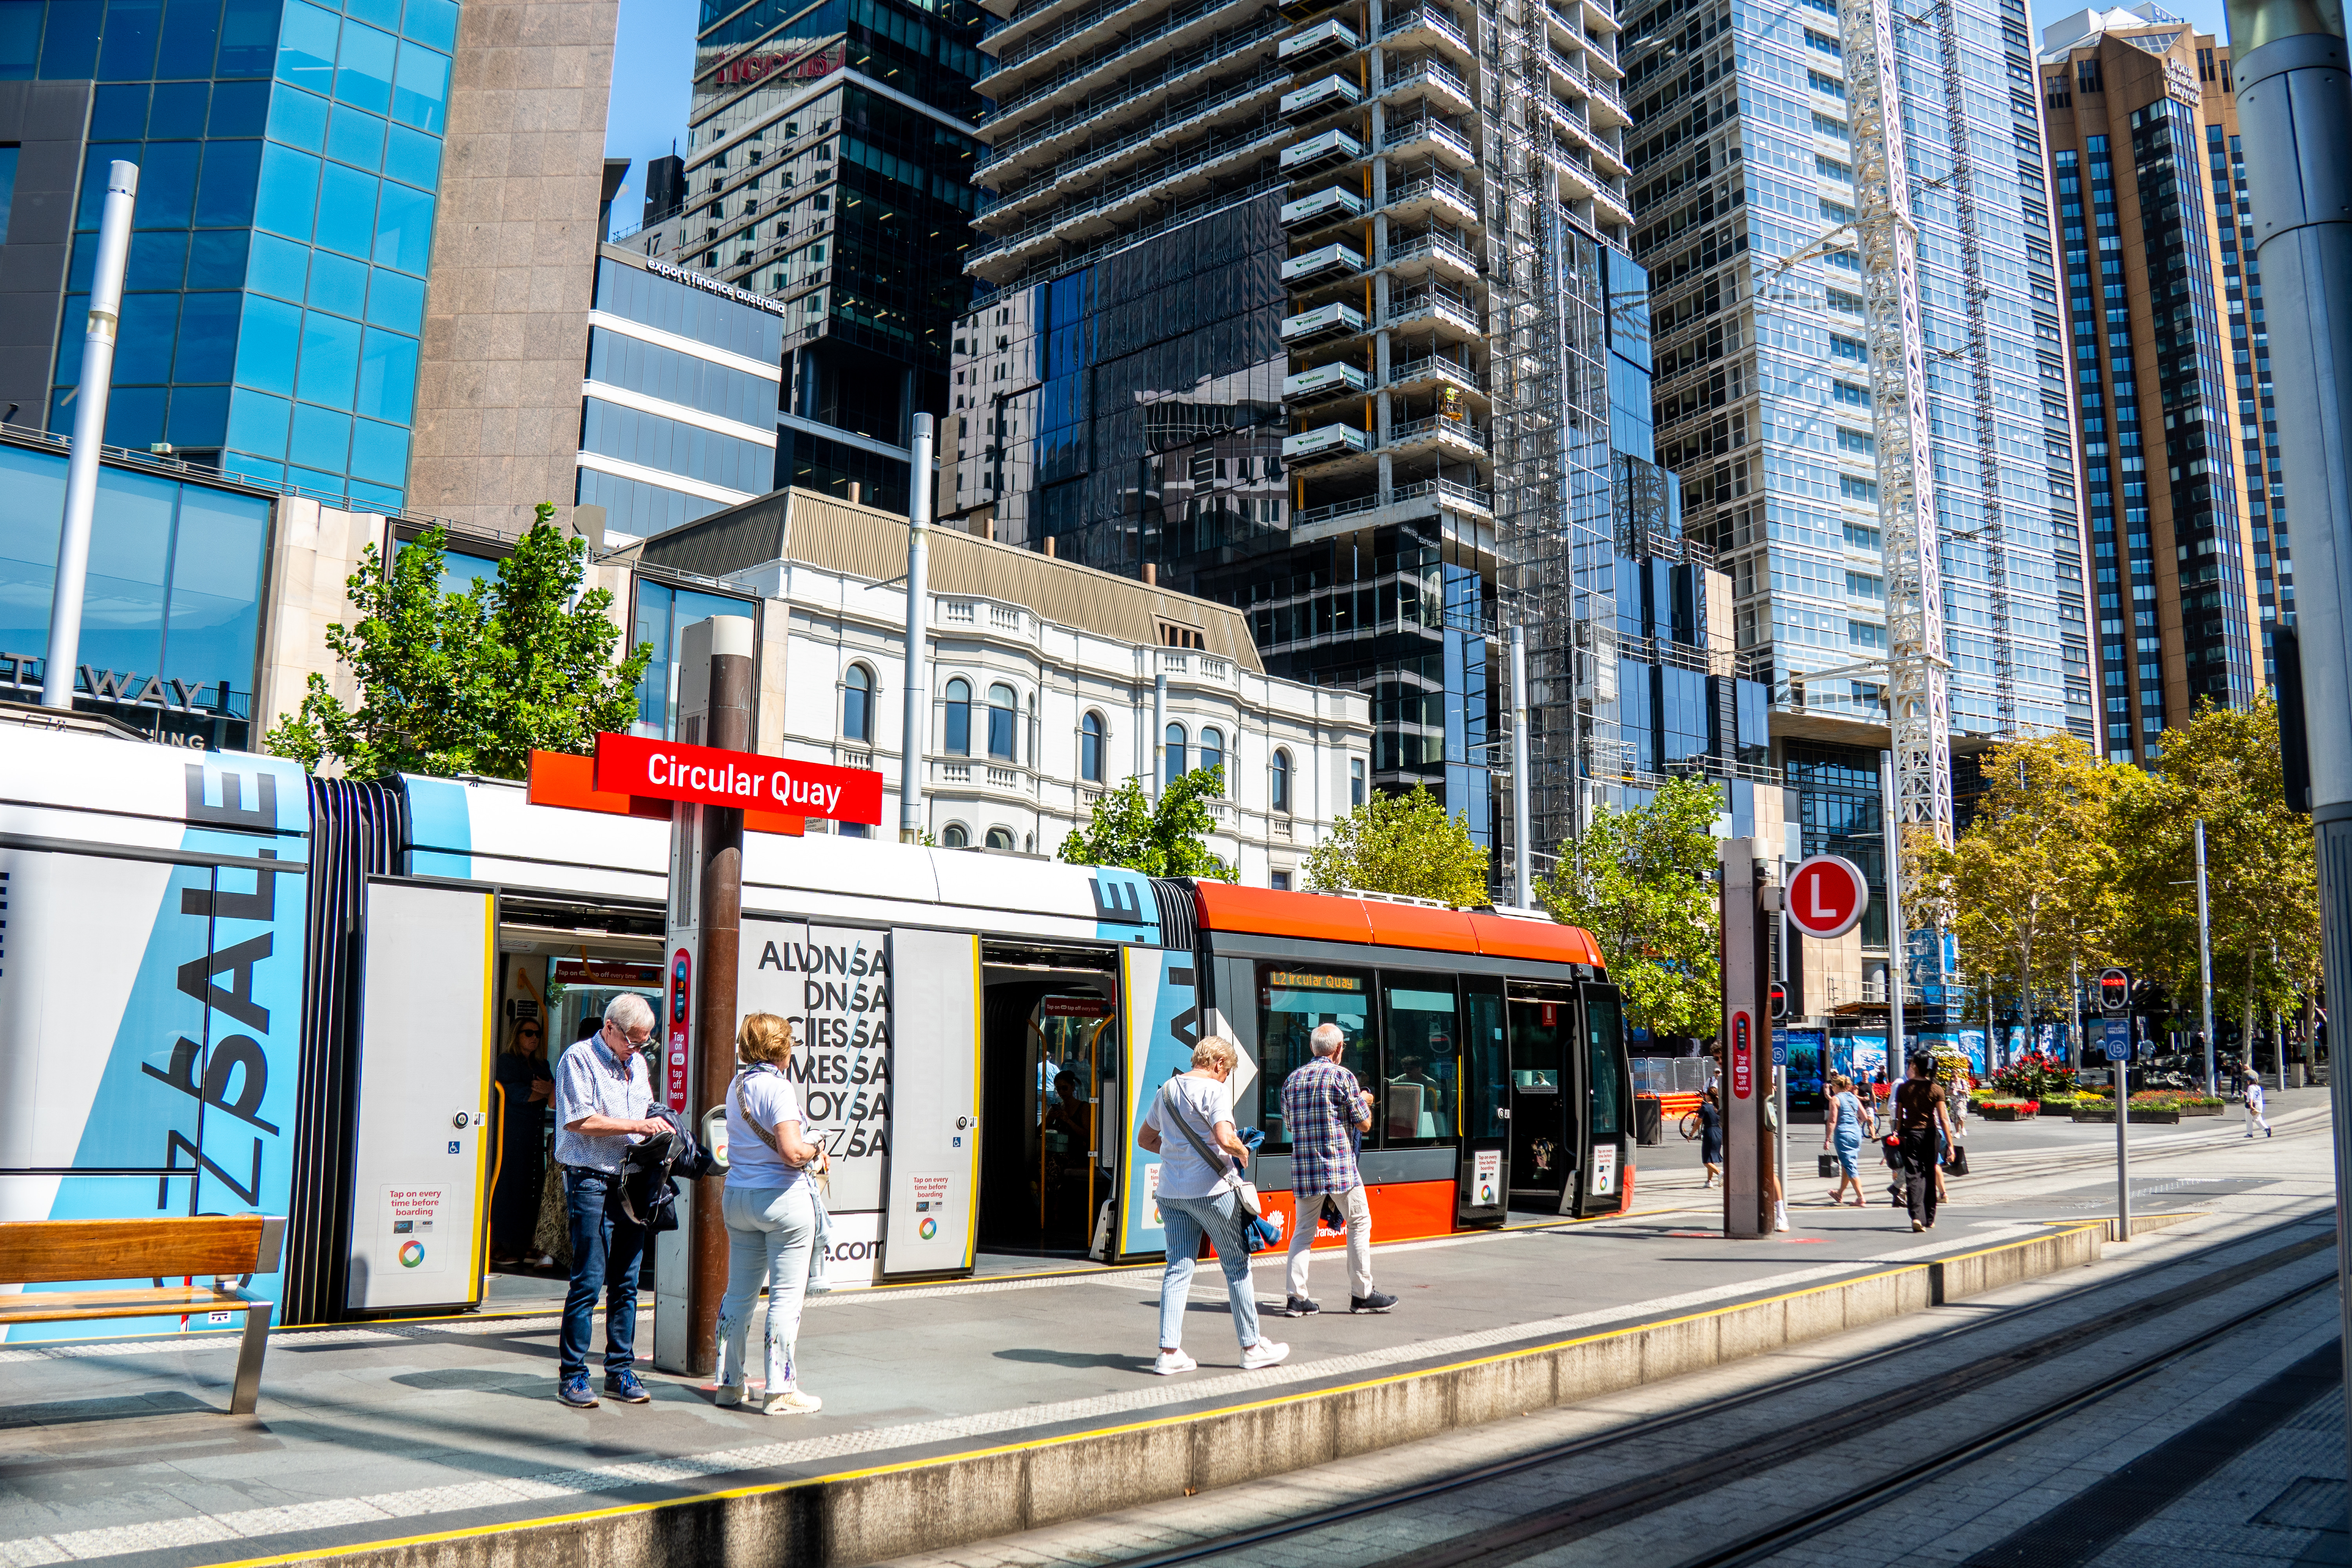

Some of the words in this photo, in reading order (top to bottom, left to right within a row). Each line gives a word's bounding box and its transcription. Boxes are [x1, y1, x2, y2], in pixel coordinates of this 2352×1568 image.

[1300, 33, 1318, 43] lendlease
[2170, 58, 2194, 77] FOUR
[2165, 65, 2202, 93] SEASONS
[1302, 89, 1320, 99] lendlease
[2170, 81, 2200, 105] HOTEL
[1302, 143, 1320, 153] lendlease
[1303, 200, 1321, 209] lendlease
[1303, 256, 1321, 266] lendlease
[648, 260, 688, 281] export
[691, 272, 734, 296] finance
[736, 289, 785, 314] australia
[1303, 315, 1322, 324] lendlease
[1305, 374, 1324, 383] lendlease
[81, 664, 206, 712] WAY
[648, 753, 765, 798] Circular
[771, 771, 842, 814] Quay
[1811, 874, 1837, 918] L
[1273, 972, 1286, 985] L2
[1326, 975, 1352, 989] Quay
[673, 1032, 684, 1043] Tap
[2113, 1044, 2122, 1053] 15
[1773, 1051, 1781, 1059] 15
[673, 1069, 682, 1079] tap
[673, 1080, 682, 1089] off
[670, 1089, 684, 1100] here
[396, 1208, 433, 1217] boarding
